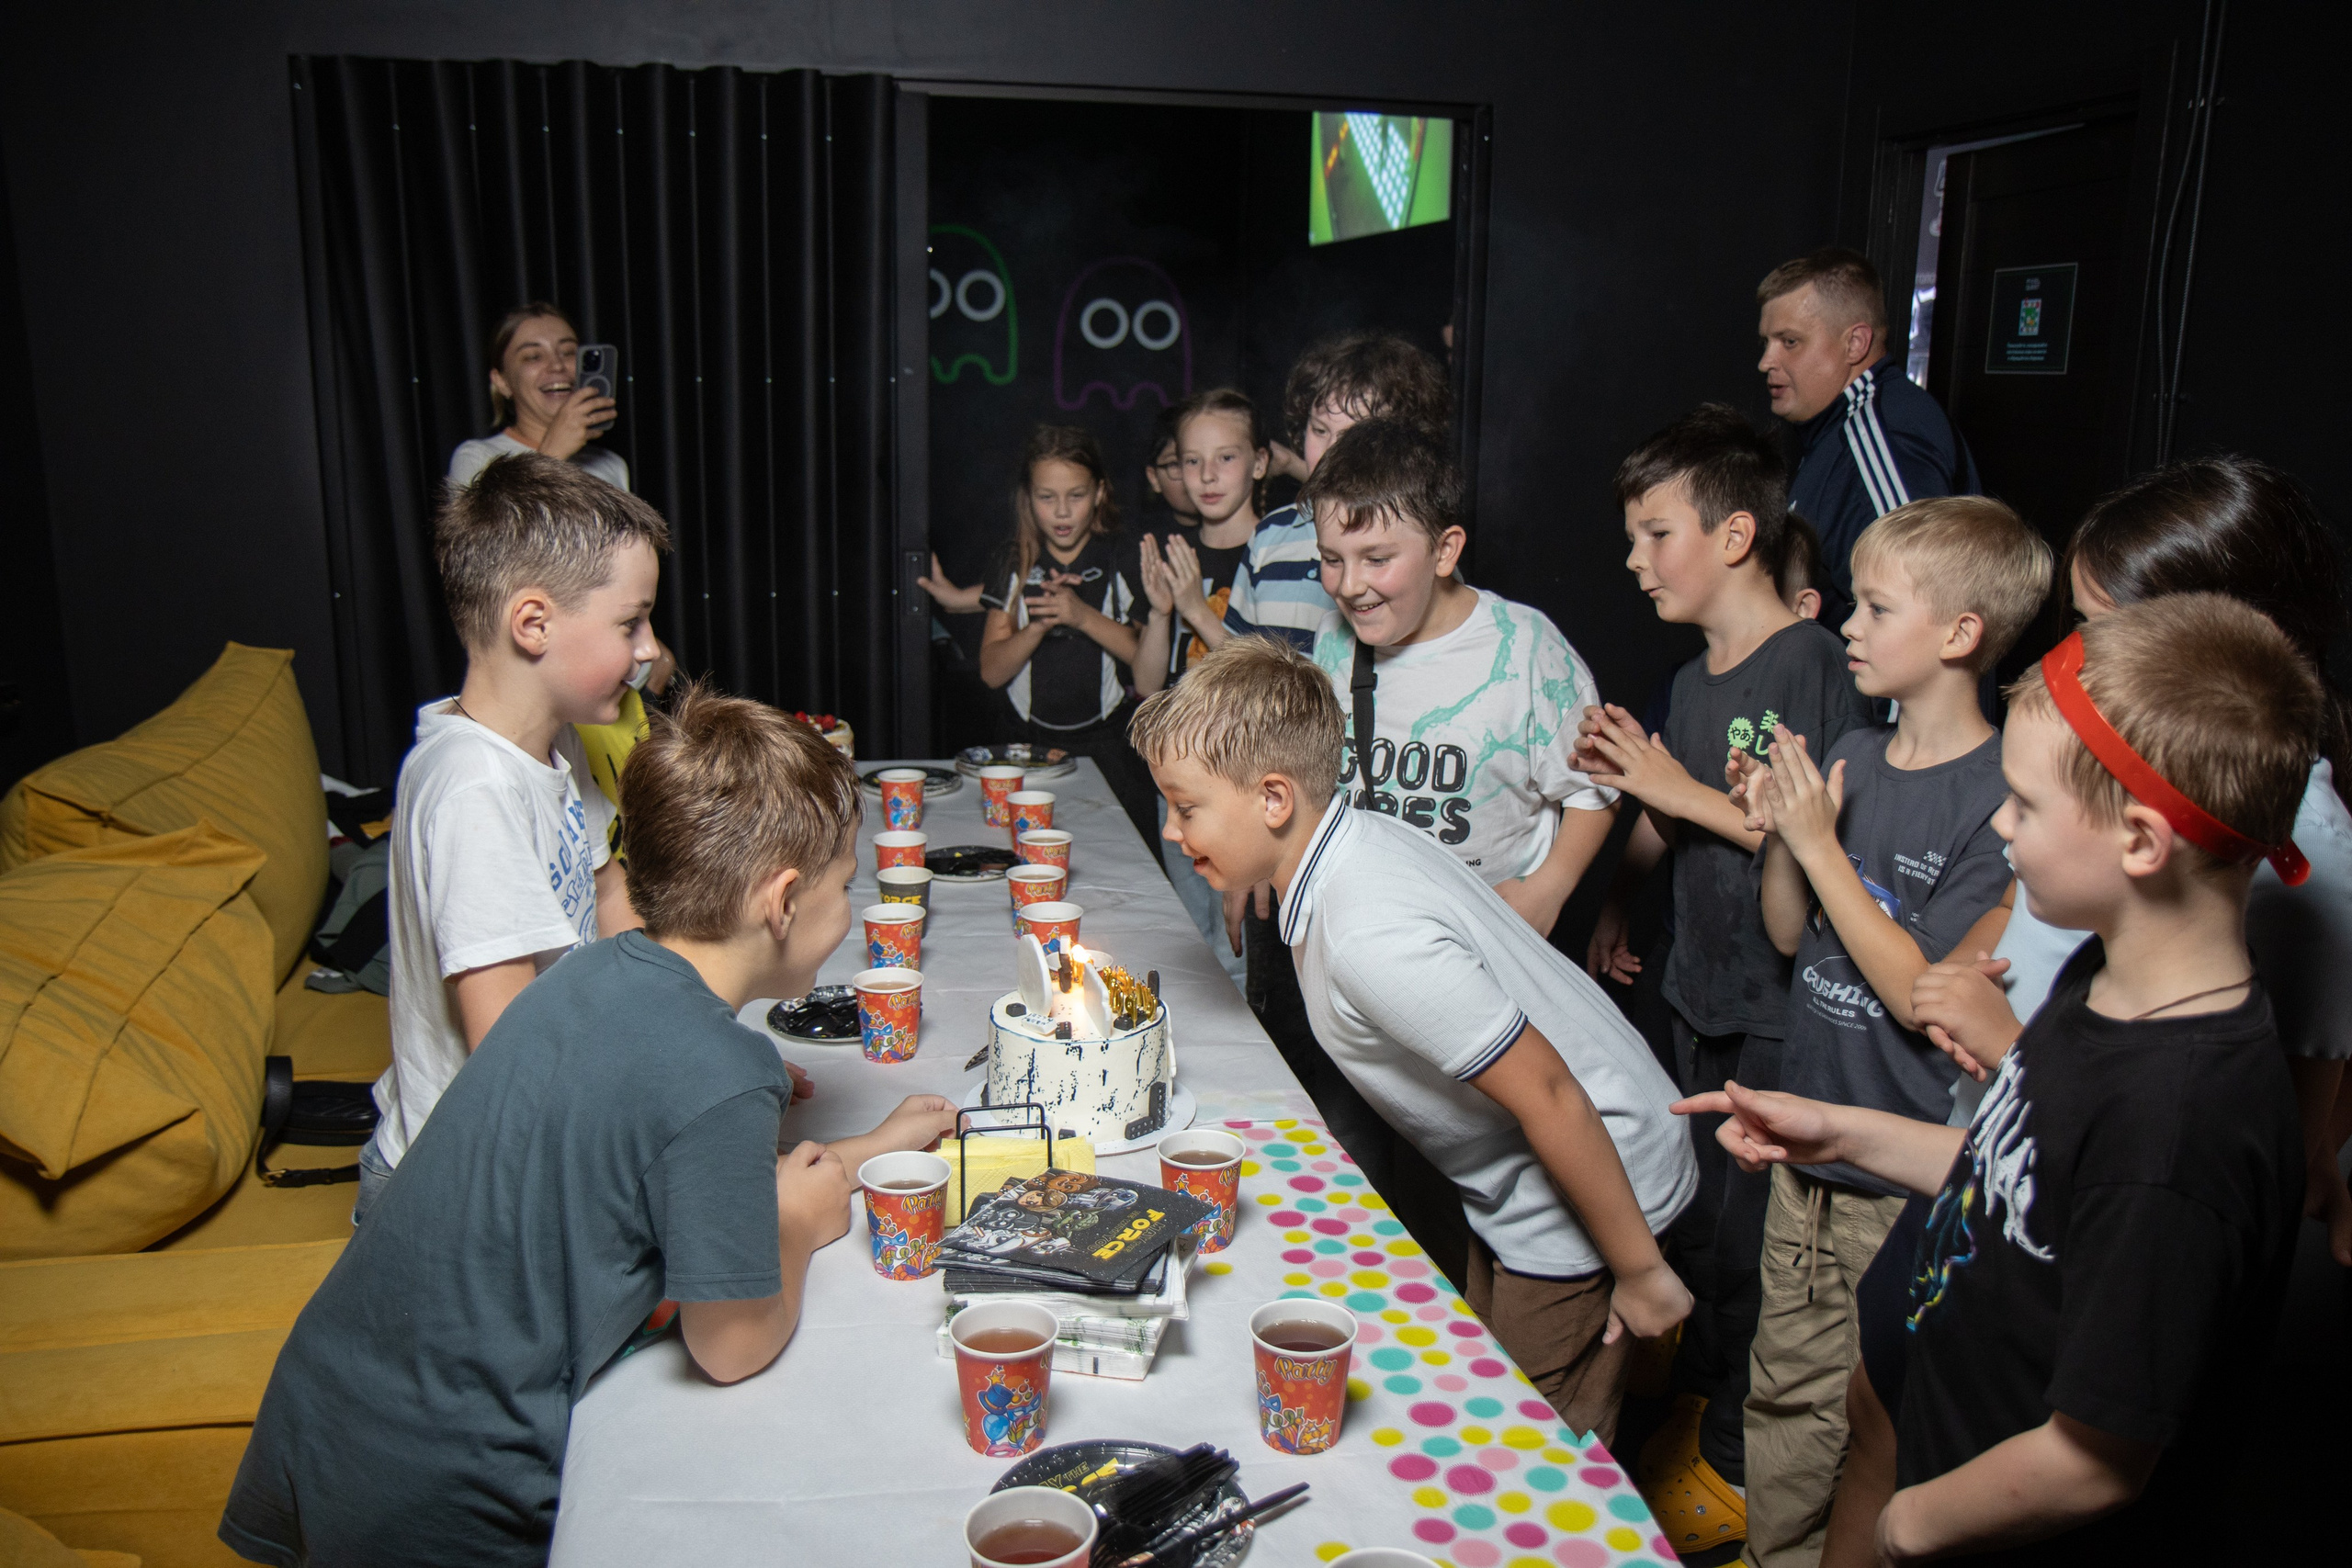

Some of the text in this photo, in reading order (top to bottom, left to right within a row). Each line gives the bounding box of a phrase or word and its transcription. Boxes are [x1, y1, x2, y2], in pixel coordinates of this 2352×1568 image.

[1337, 738, 1467, 793] GOOD
[1802, 965, 1884, 1017] CRUSHING
[1826, 1005, 1856, 1018] RULES
[1091, 1208, 1166, 1261] FORCE
[1273, 1355, 1338, 1385] Party
[1063, 1461, 1091, 1481] THE
